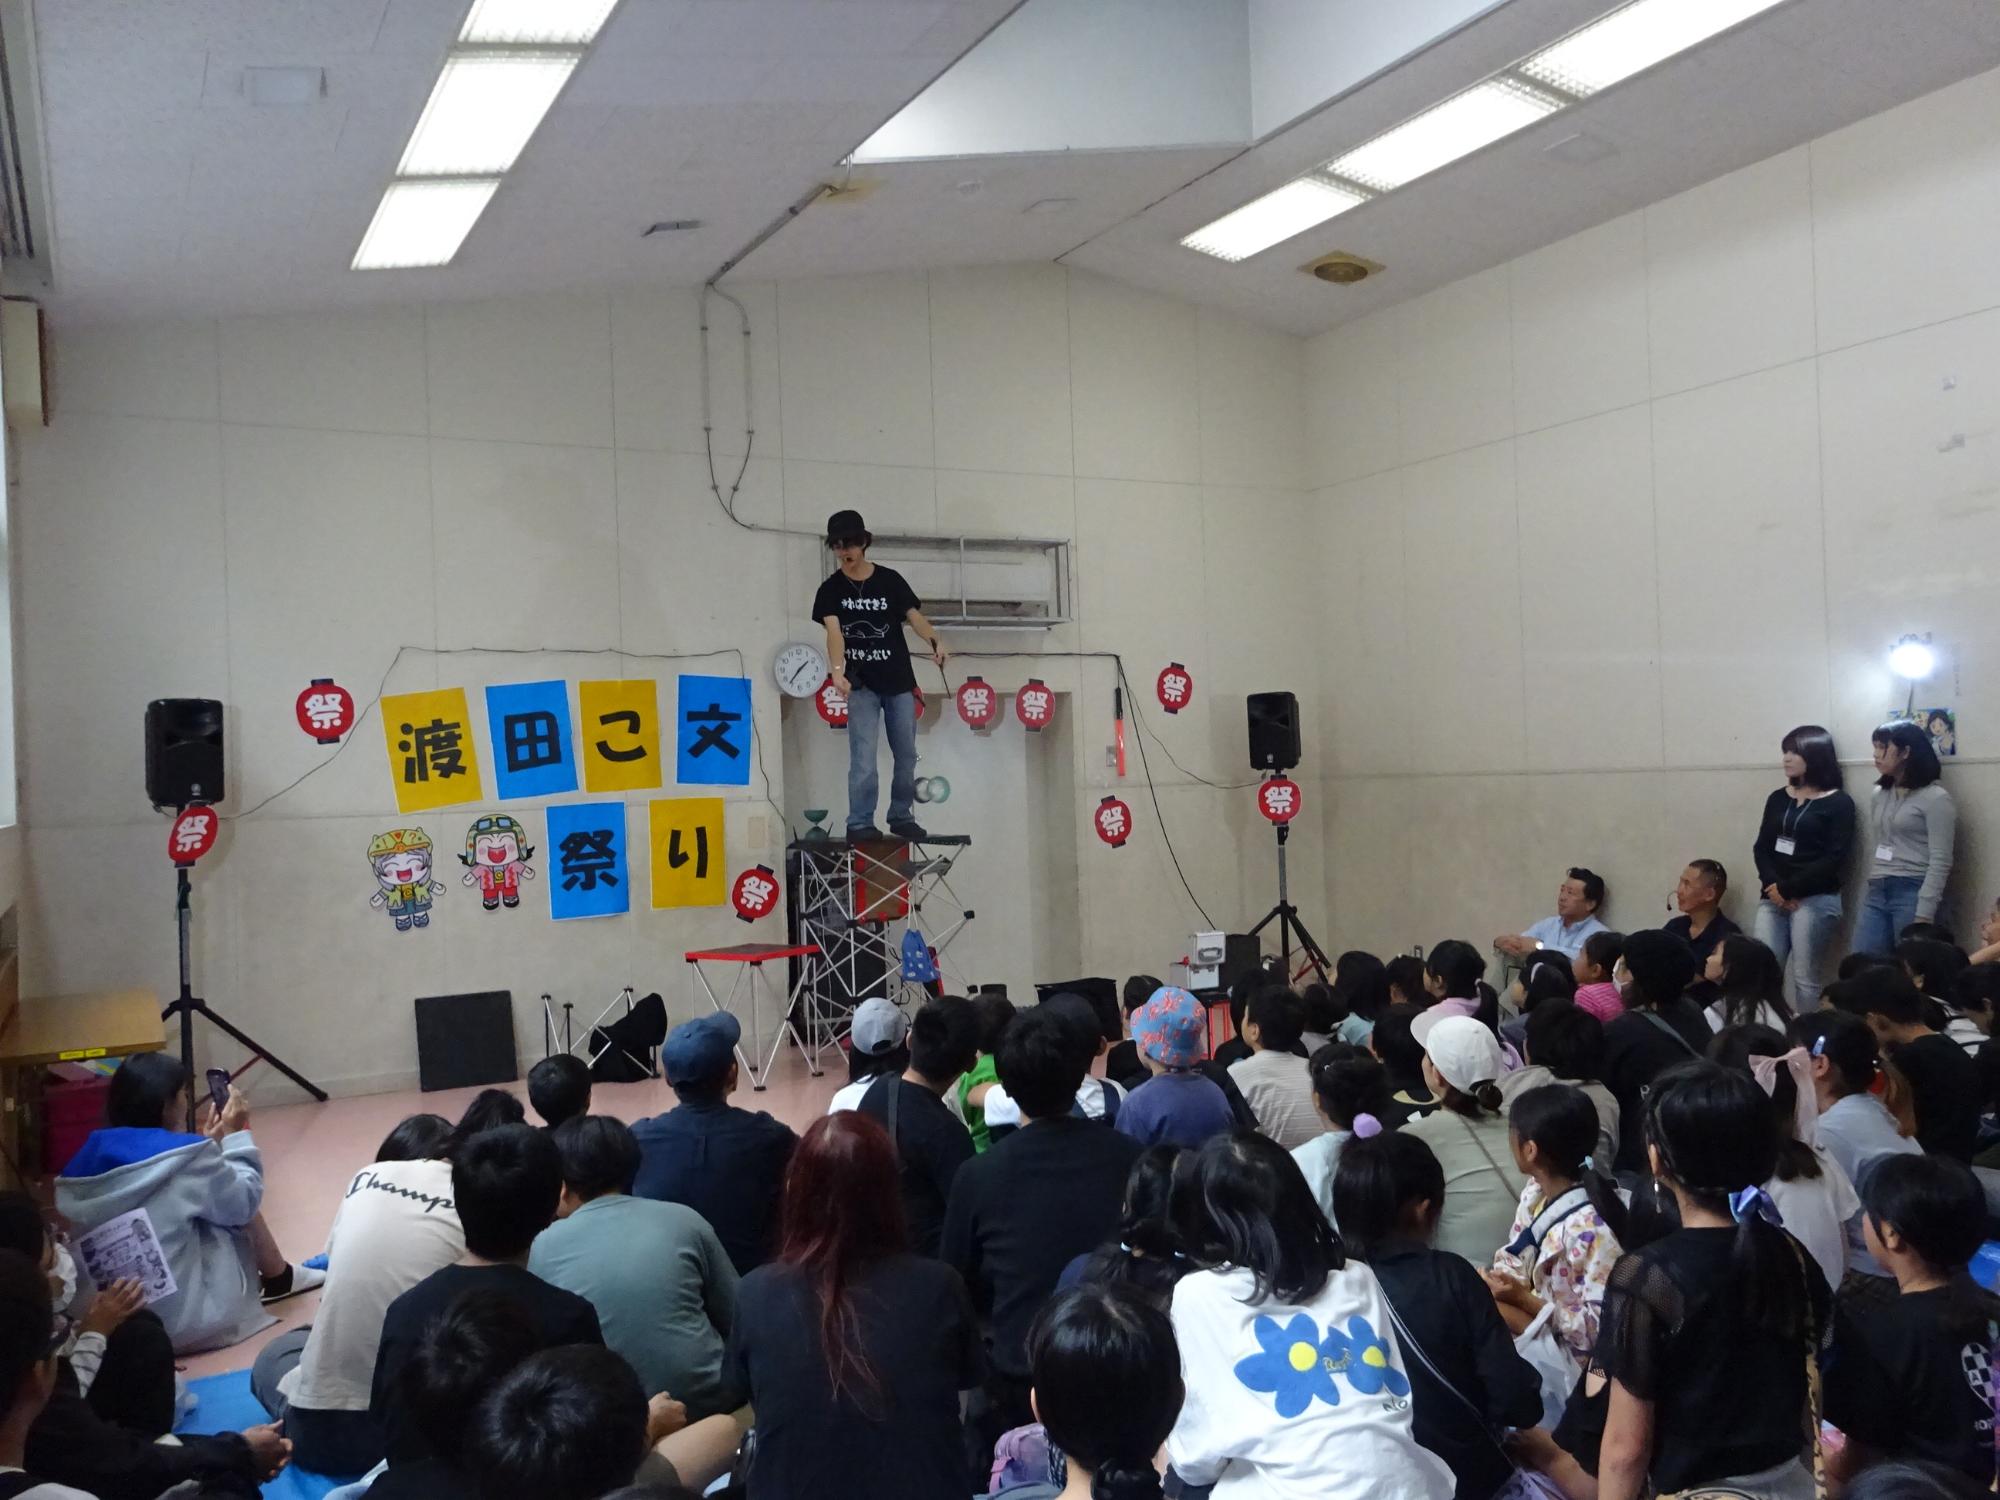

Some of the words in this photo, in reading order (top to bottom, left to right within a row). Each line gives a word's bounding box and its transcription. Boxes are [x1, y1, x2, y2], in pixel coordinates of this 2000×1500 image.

[822, 686, 848, 717] 祭
[962, 688, 990, 719] 祭
[1164, 674, 1187, 702] 祭
[305, 693, 344, 730] 祭
[1022, 690, 1048, 721] 祭
[398, 703, 741, 784] 渡田こ文
[1265, 786, 1294, 815] 祭
[176, 815, 210, 853] 祭
[1100, 805, 1125, 837] 祭
[560, 827, 709, 890] 祭り
[740, 875, 773, 911] 祭
